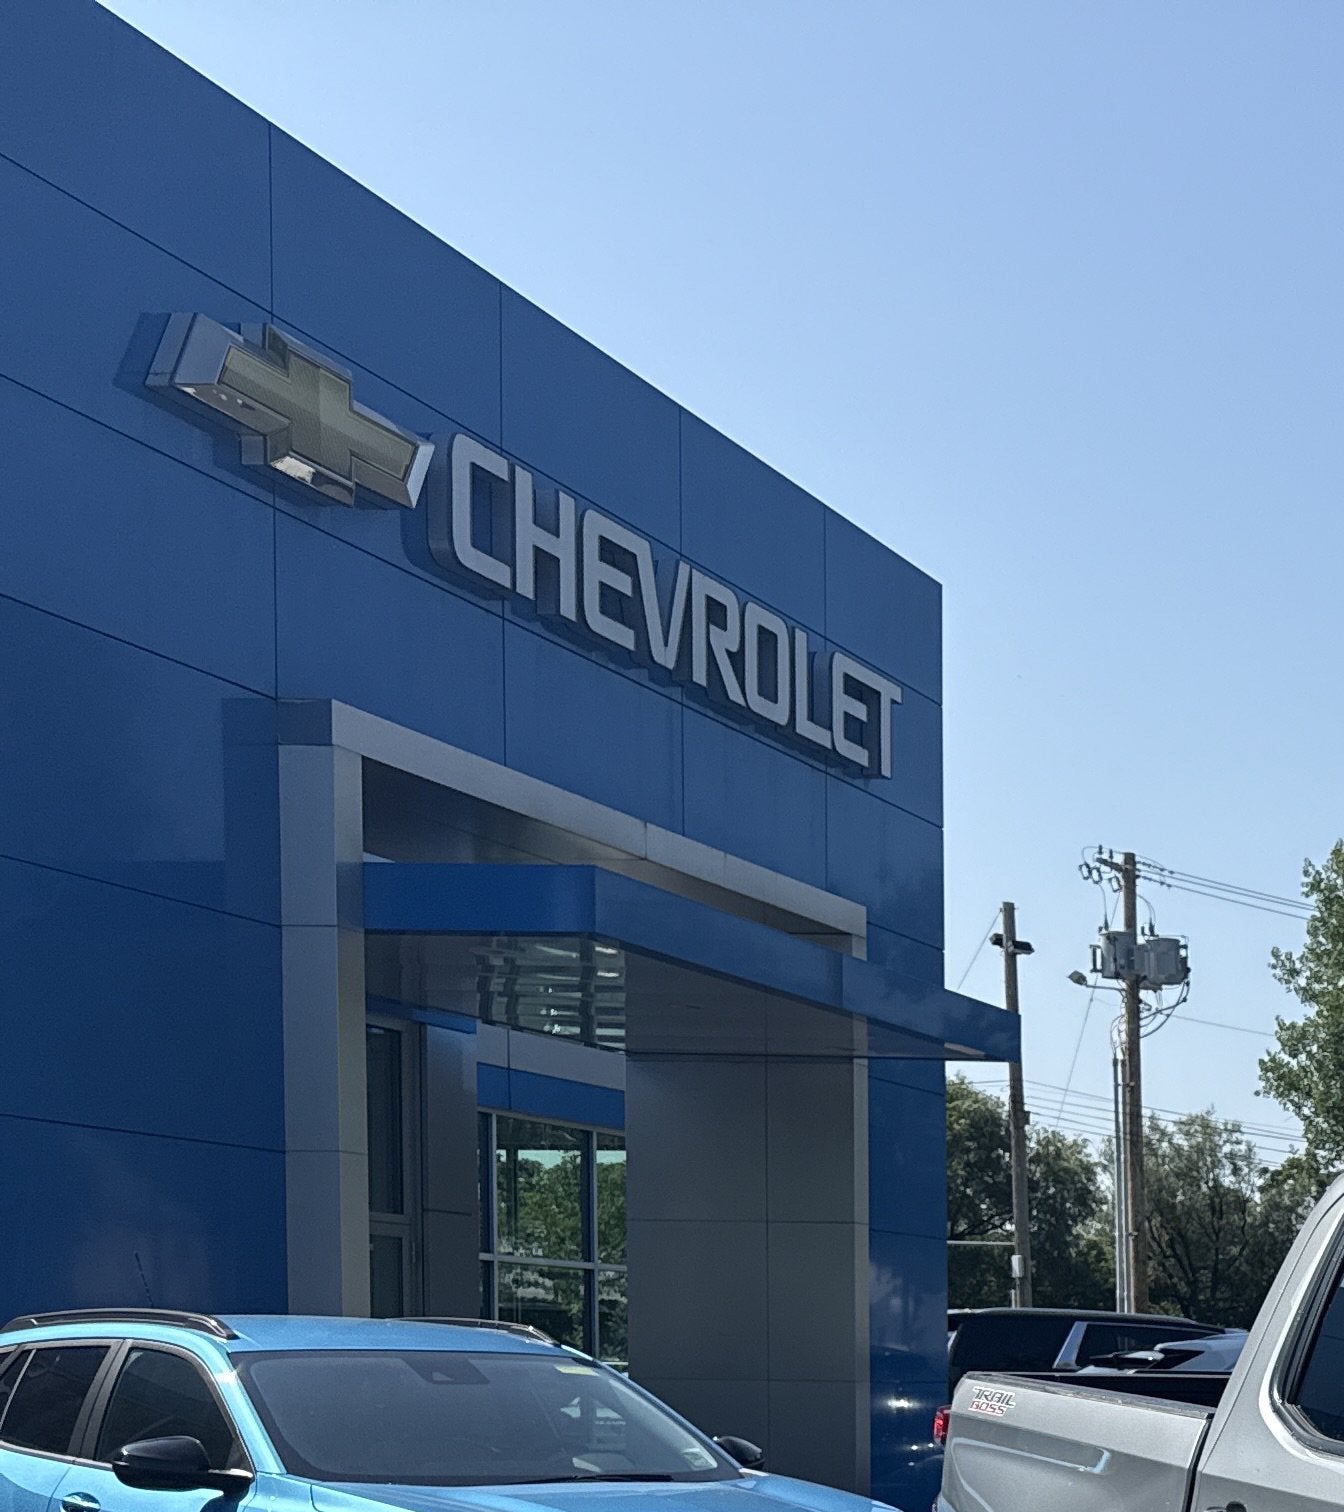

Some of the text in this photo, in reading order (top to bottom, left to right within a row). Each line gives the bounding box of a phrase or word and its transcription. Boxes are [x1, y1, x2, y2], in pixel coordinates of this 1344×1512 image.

[450, 432, 904, 780] CHEVROLET
[969, 1400, 1008, 1416] BOSS
[973, 1386, 1016, 1408] TRAIL
